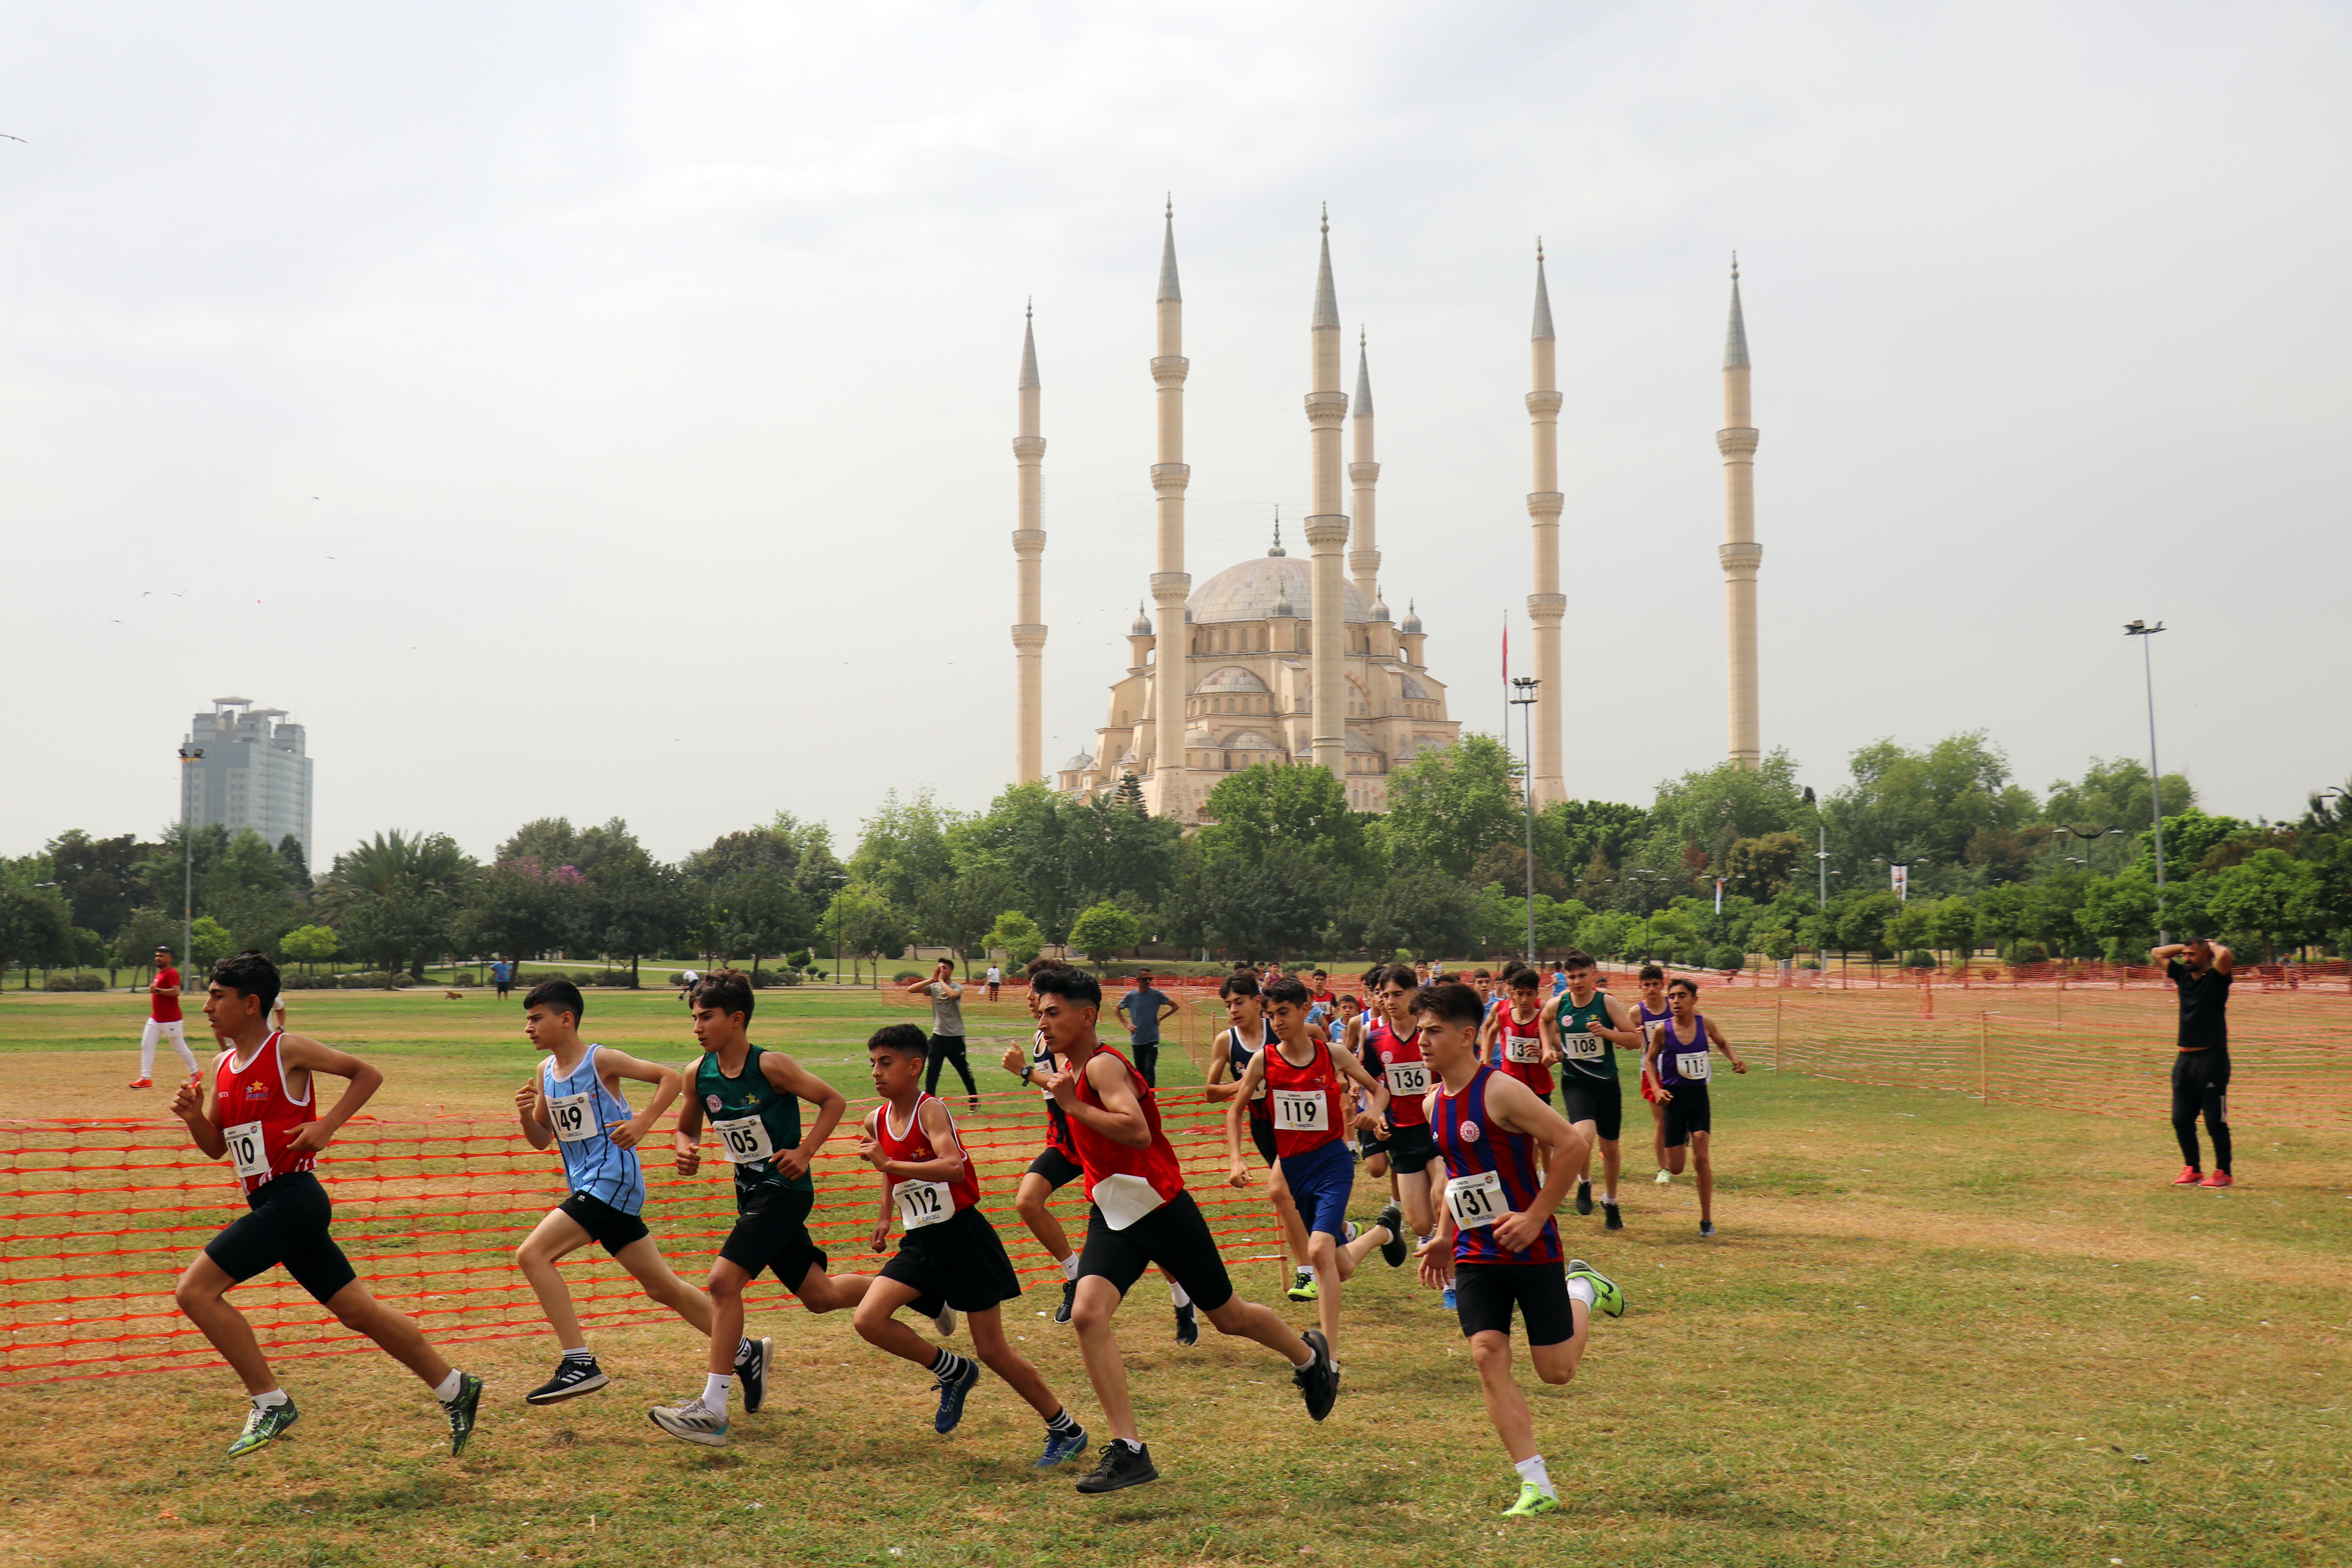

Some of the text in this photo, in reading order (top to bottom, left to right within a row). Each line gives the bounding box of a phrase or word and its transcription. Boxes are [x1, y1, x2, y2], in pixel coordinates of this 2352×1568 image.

[1512, 1043, 1530, 1057] 13
[1573, 1038, 1596, 1053] 108
[1395, 1070, 1423, 1089] 136
[552, 1106, 582, 1131] 149
[1284, 1102, 1316, 1122] 119
[722, 1129, 758, 1153] 105
[228, 1137, 254, 1166] 110
[909, 1182, 934, 1192] FEDERASYONU
[904, 1187, 942, 1216] 112
[1454, 1188, 1492, 1218] 131
[1471, 1214, 1495, 1222] TURKCELL
